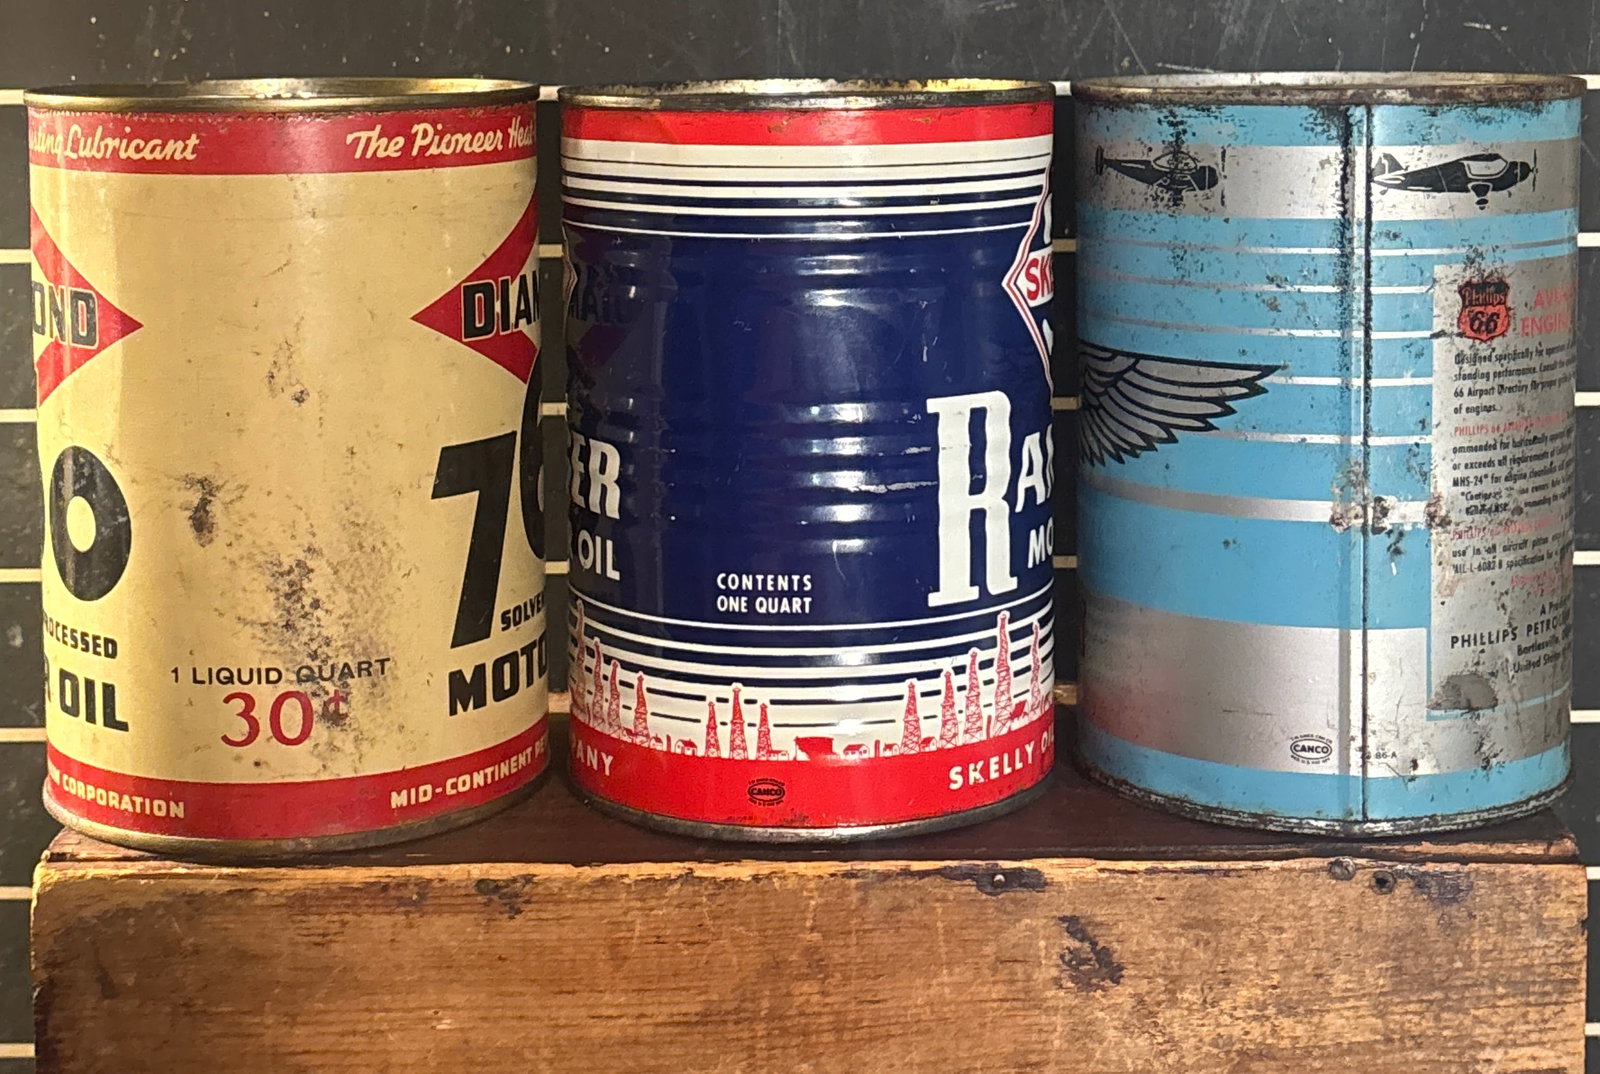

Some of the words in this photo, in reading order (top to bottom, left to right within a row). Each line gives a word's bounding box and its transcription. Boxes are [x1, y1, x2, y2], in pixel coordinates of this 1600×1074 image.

[64, 124, 200, 161] Lubricant
[346, 124, 406, 160] The
[411, 122, 503, 157] Pioneer
[1469, 310, 1500, 334] 66
[1454, 387, 1464, 398] 66
[1467, 386, 1495, 399] Airport
[1454, 403, 1462, 415] of
[1454, 424, 1489, 437] PHILLIPS
[1452, 462, 1461, 471] or
[1464, 457, 1496, 470] exceeds
[1491, 473, 1500, 484] for
[577, 529, 621, 581] OIL
[717, 573, 812, 591] CONTENTS
[717, 595, 748, 612] ONE
[755, 596, 812, 614] QUART
[1540, 603, 1546, 617] A
[1451, 627, 1519, 649] PHILLIPS
[171, 666, 180, 684] 1
[192, 666, 283, 685] LIQUID
[296, 657, 391, 683] QUART
[59, 667, 129, 732] OIL
[1292, 743, 1330, 754] CANCO
[949, 740, 1035, 790] SKELLY
[390, 746, 533, 809] MID-CONTINENT
[62, 773, 185, 819] CORPORATION
